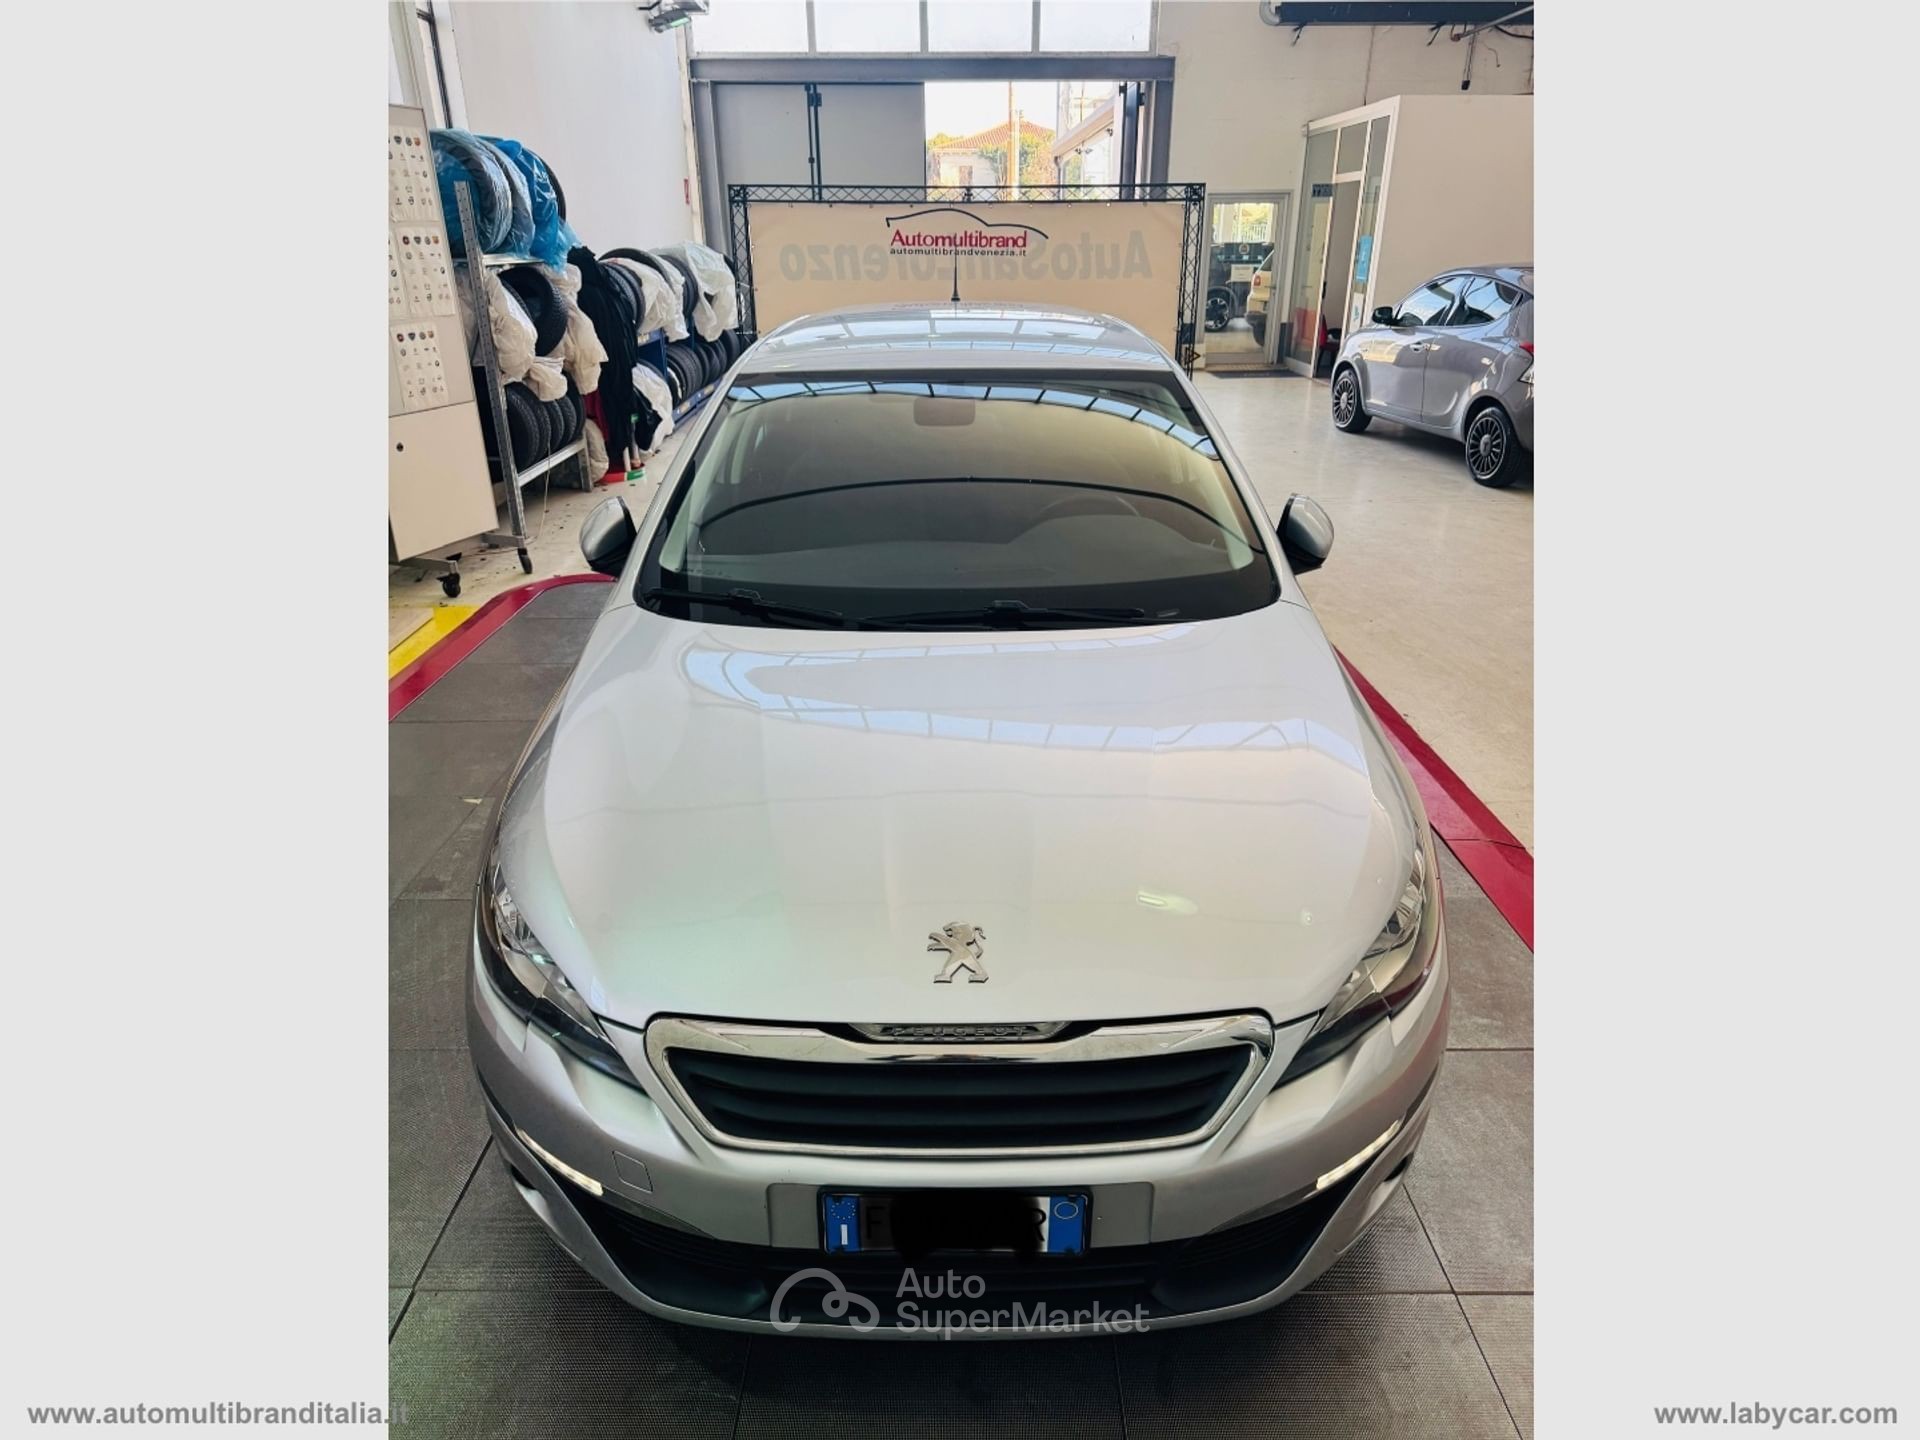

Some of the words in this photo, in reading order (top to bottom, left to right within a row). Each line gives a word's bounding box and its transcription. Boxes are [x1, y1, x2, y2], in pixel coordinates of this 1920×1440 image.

[890, 229, 1027, 249] Automultibrand
[889, 247, 1026, 257] automultibrandvenezia.it
[893, 1025, 1027, 1036] PEUGEOT
